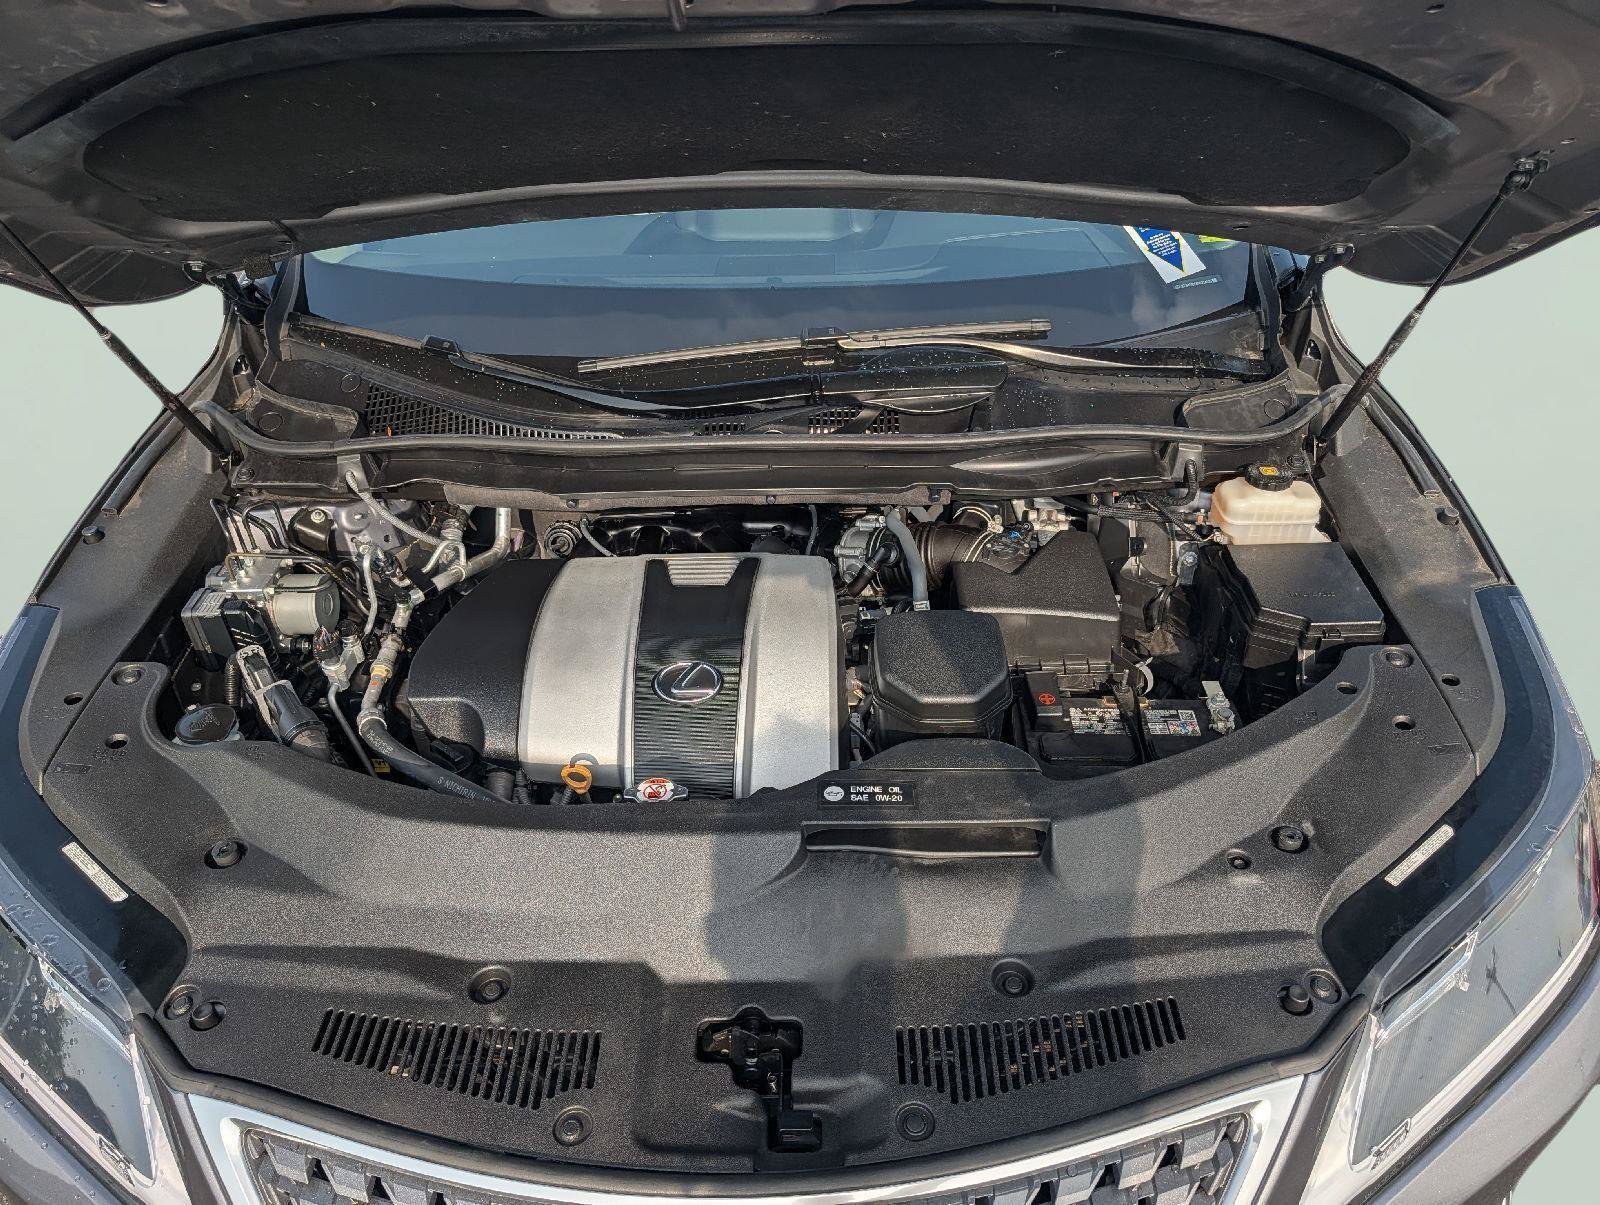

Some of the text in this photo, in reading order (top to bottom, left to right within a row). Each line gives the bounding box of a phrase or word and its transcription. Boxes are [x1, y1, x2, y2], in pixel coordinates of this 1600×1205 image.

[850, 785, 883, 793] ENGINE
[850, 794, 903, 802] SAE 0W-20
